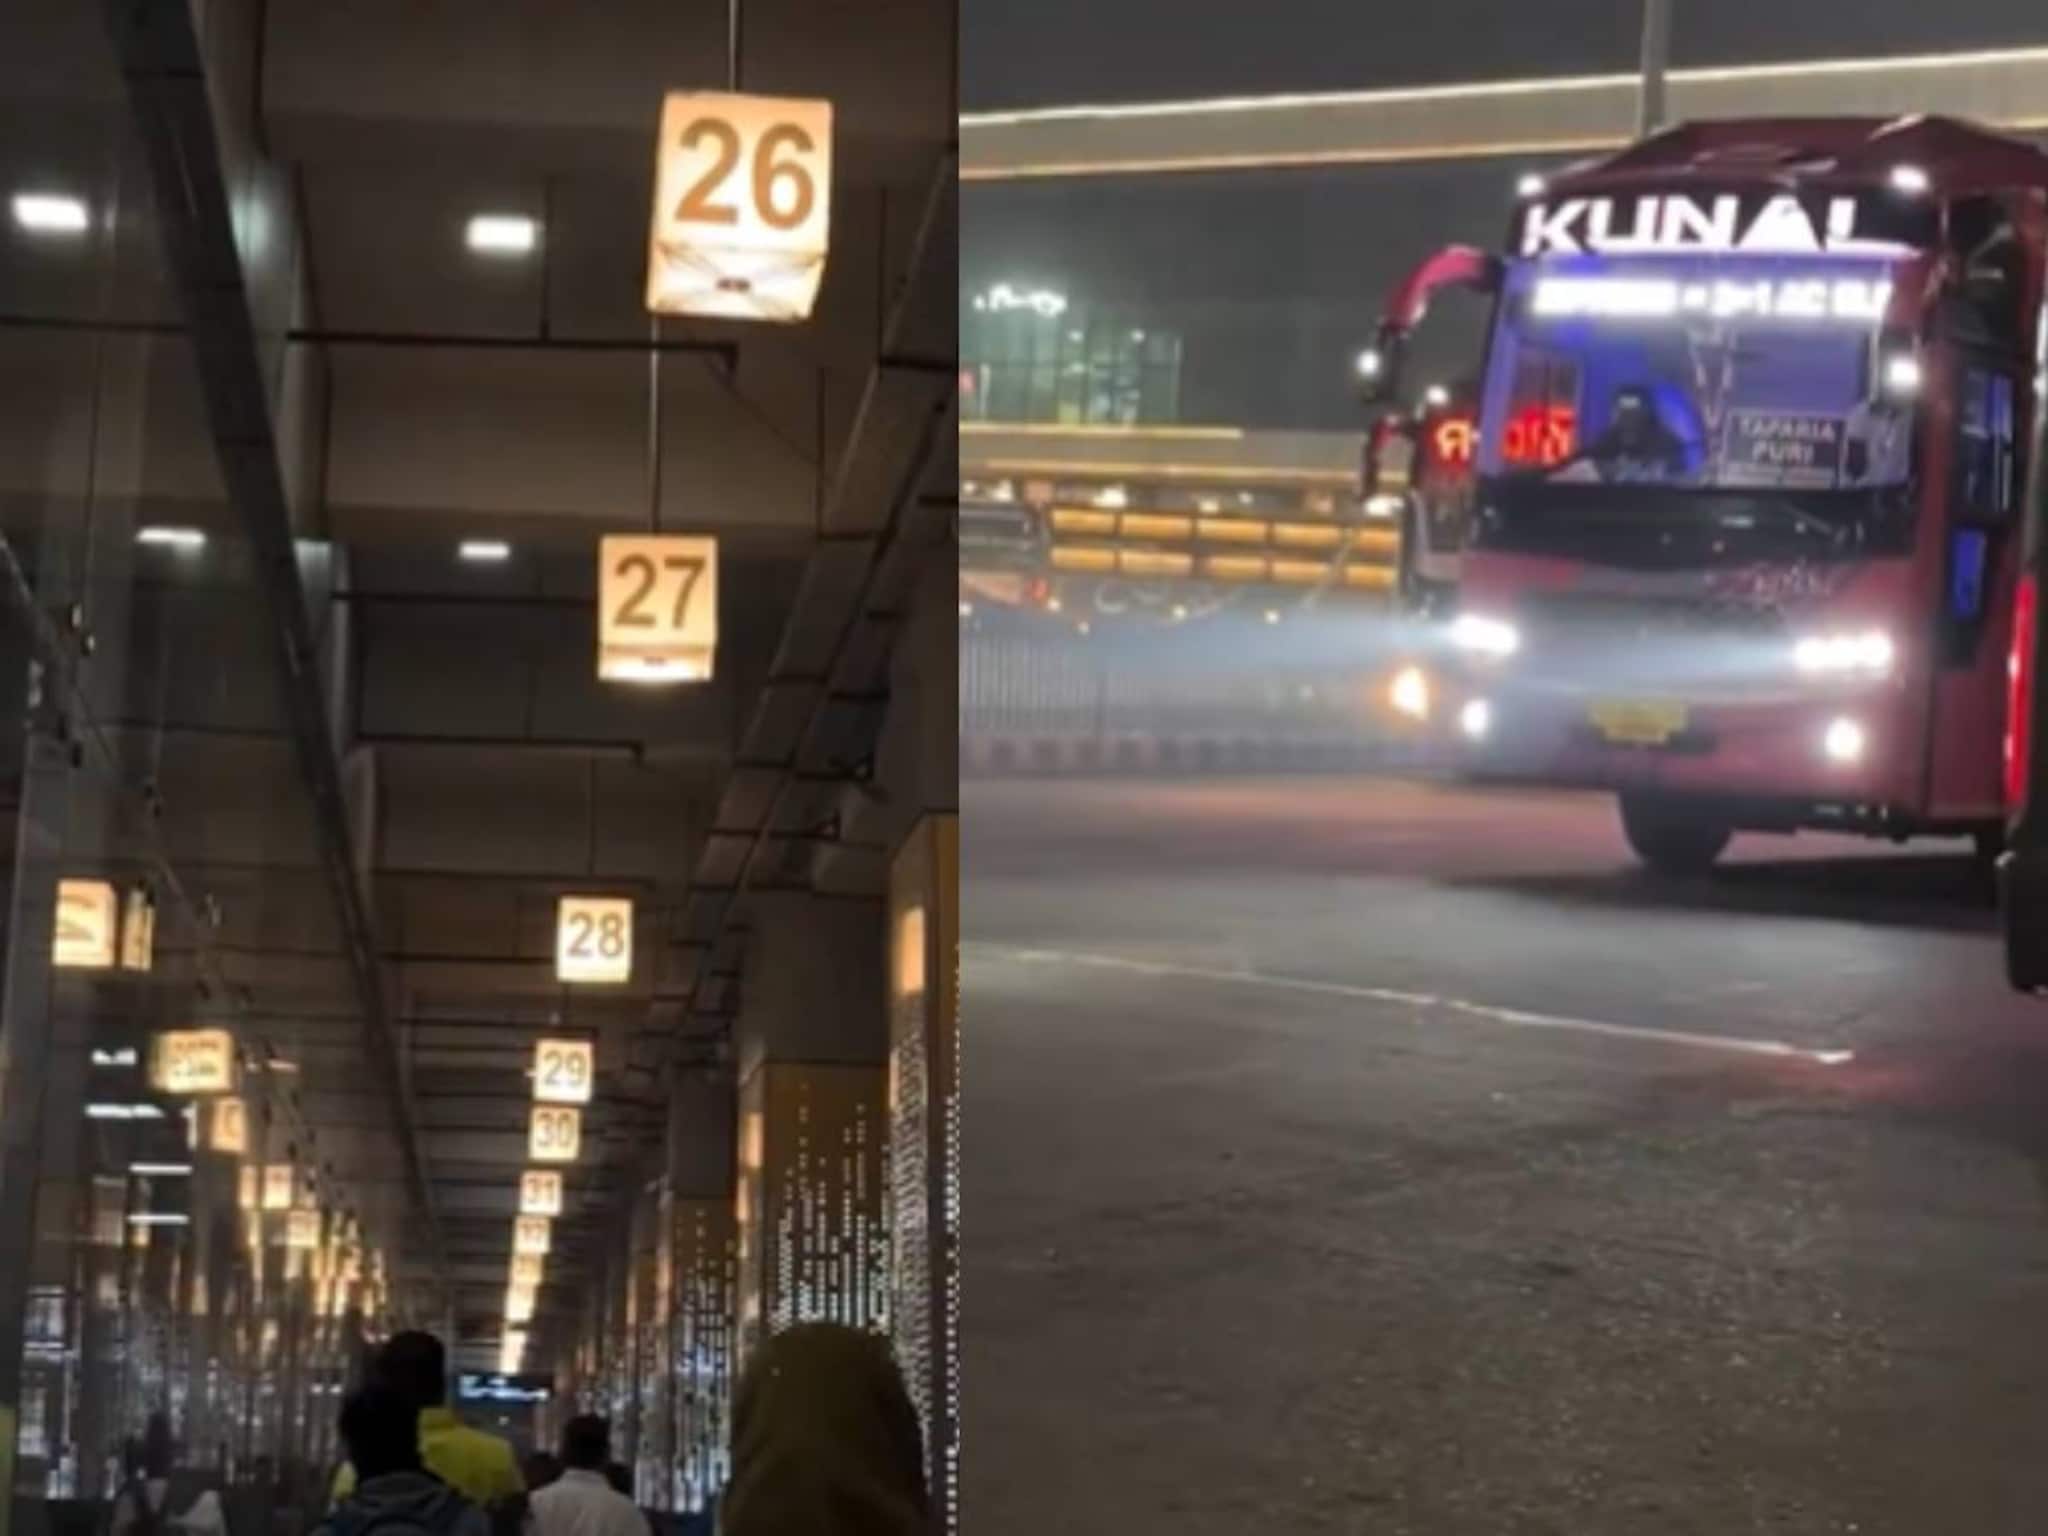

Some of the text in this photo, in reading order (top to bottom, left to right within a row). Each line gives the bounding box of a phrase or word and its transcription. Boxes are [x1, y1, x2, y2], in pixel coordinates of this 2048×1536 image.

[673, 117, 816, 231] 26
[1521, 194, 1922, 258] KUNAL
[613, 554, 706, 629] 27
[565, 911, 625, 958] 28
[543, 1051, 587, 1088] 29
[536, 1112, 572, 1148] 30
